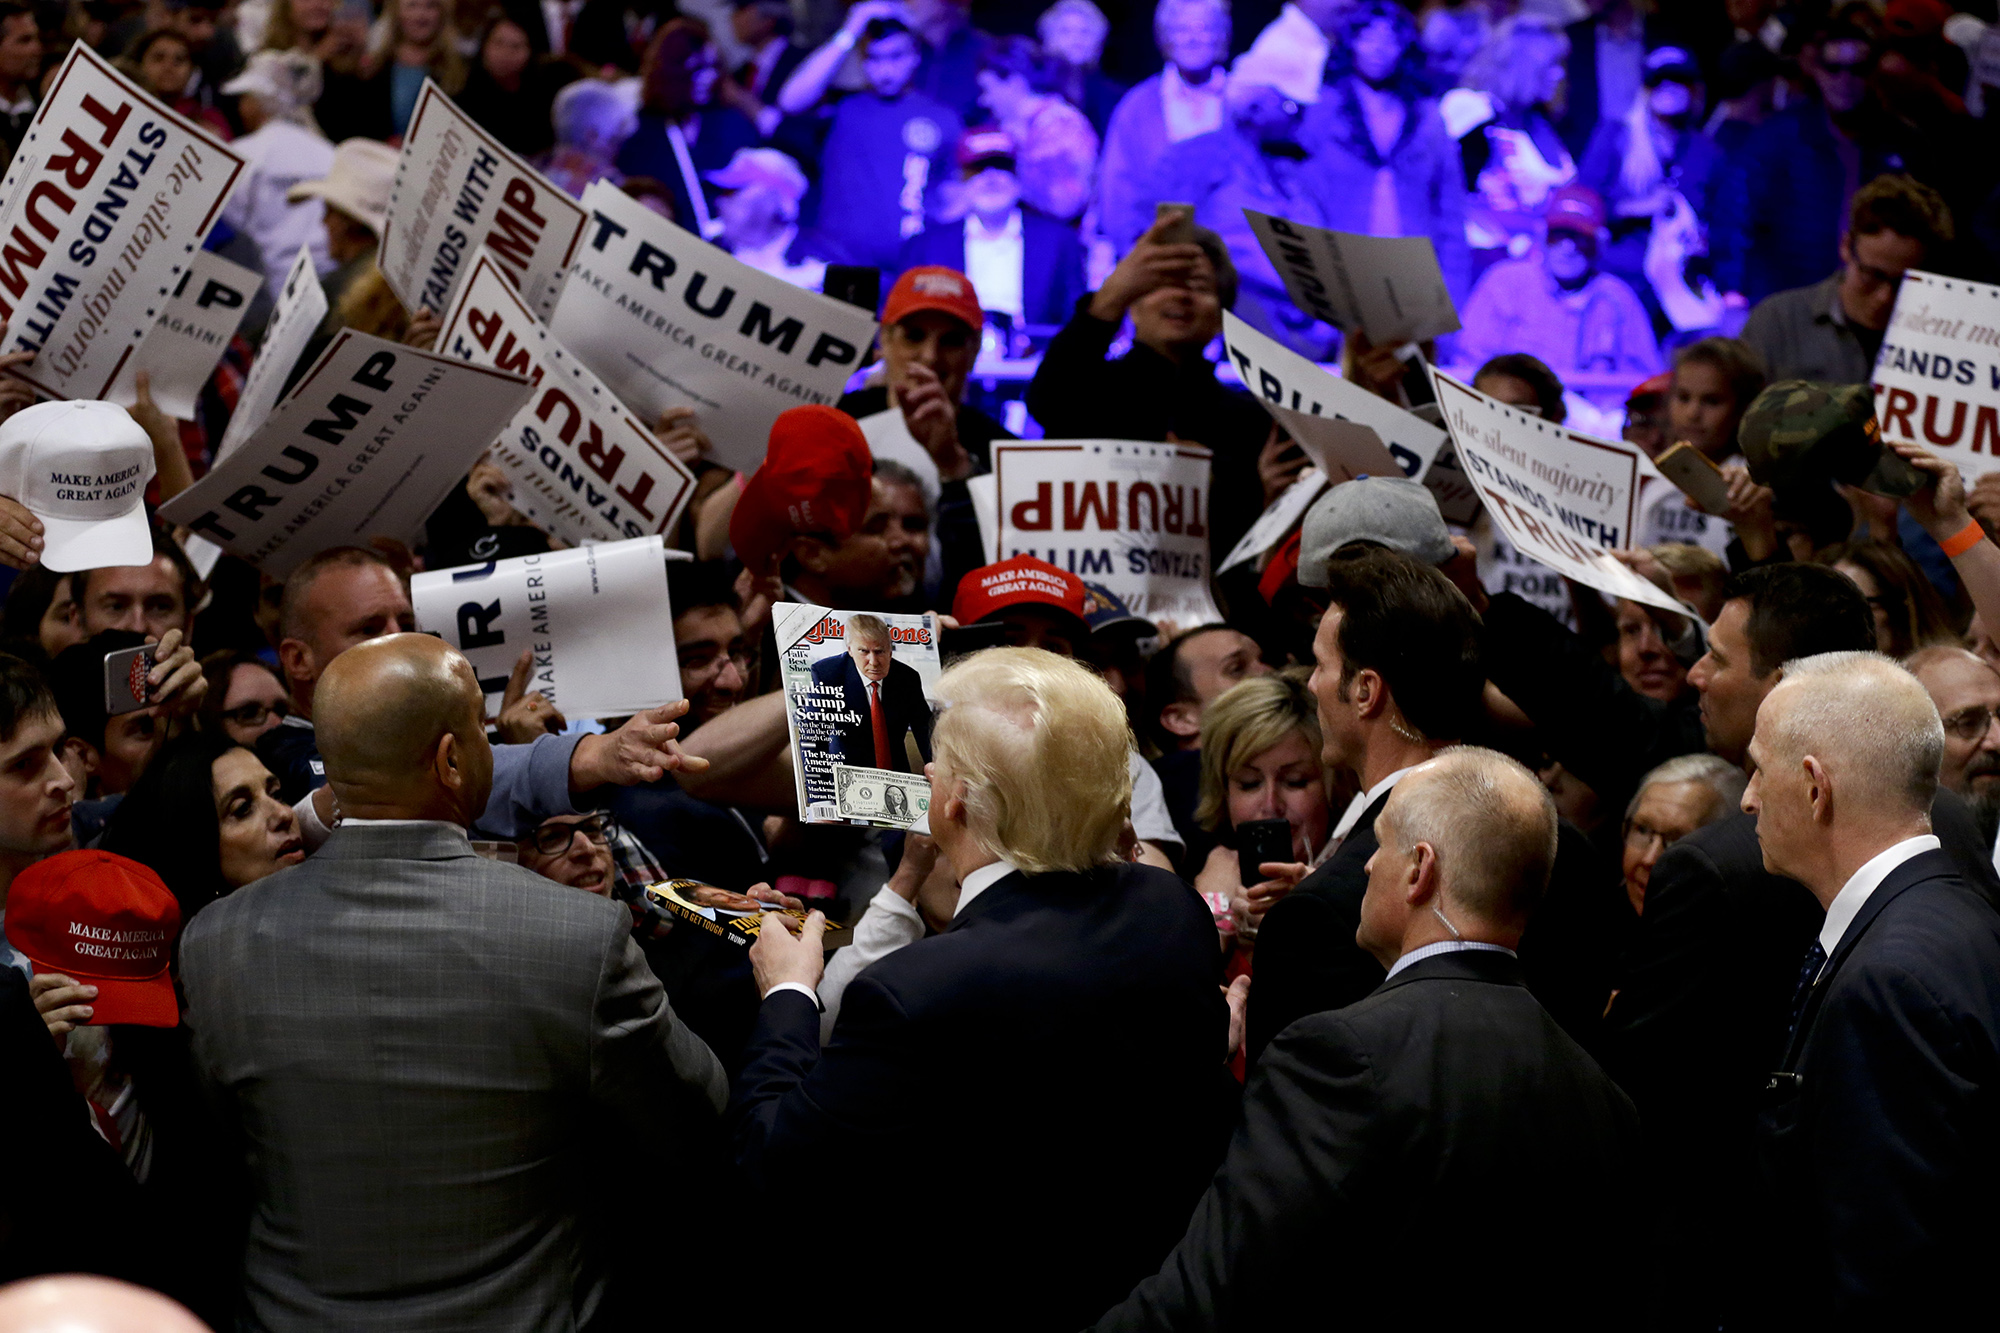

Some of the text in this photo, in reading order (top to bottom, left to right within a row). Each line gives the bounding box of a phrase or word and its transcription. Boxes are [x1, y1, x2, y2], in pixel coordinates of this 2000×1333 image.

[68, 121, 168, 267] STANDS
[453, 146, 499, 225] WITH
[0, 93, 133, 322] TRUM
[49, 144, 204, 388] the silent majority
[592, 208, 858, 368] TRUMP
[156, 312, 225, 347] AGAIN!
[615, 292, 696, 350] AMERICA
[700, 343, 761, 380] GREAT
[190, 350, 398, 542] TRUMP
[285, 474, 352, 538] AMERICA
[346, 424, 397, 477] GREAT
[392, 364, 447, 426] AGAIN!
[1452, 408, 1480, 438] the
[1482, 428, 1528, 471] silent
[1530, 461, 1624, 516] majority
[51, 464, 141, 487] MAKE AMERICA
[56, 480, 138, 502] GREAT AGAIN
[1465, 448, 1554, 518] STANDS
[1557, 509, 1619, 549] WITH
[1010, 480, 1205, 539] TRUMP
[1128, 548, 1201, 580] STANDS
[981, 568, 1070, 591] MAKE AMERICA
[988, 580, 1065, 599] GREAT AGAIN
[523, 556, 557, 704] MAKE AMERIC
[788, 658, 807, 666] Best
[791, 681, 845, 699] Taking
[793, 694, 846, 712] Trump
[796, 707, 863, 727] Seriously
[819, 722, 835, 730] Trail
[798, 727, 815, 735] With
[799, 734, 834, 744] Tough Guy
[801, 750, 846, 761] The Pope's
[803, 757, 844, 767] American
[805, 766, 835, 774] Crusad
[68, 921, 165, 943] MAKE AMERICA
[664, 900, 680, 915] TIME
[680, 908, 690, 919] TO
[689, 913, 703, 926] GET
[702, 919, 724, 937] TOUGH
[727, 931, 747, 947] TRUMP
[74, 941, 158, 960] GREAT AGAIN
